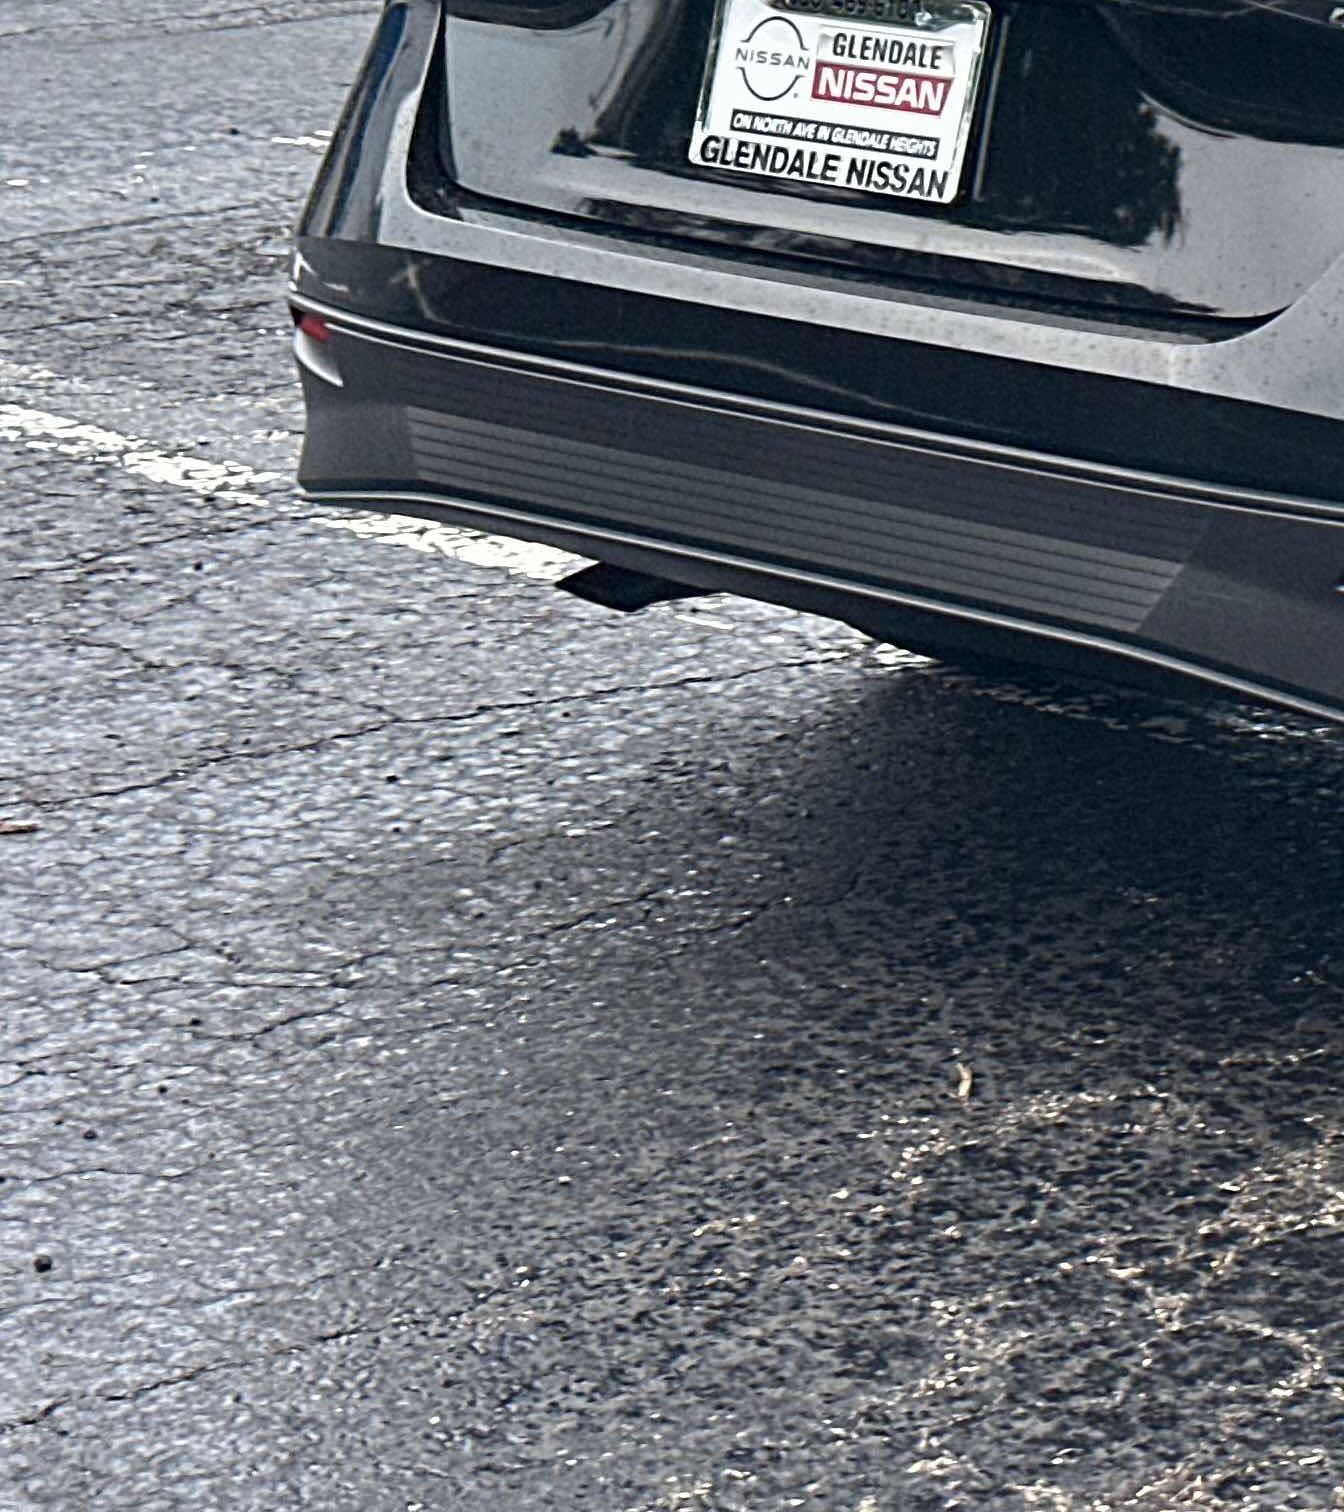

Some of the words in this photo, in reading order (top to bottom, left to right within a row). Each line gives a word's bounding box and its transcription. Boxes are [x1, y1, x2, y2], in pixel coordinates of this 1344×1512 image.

[735, 47, 811, 70] NISSAN
[832, 32, 943, 70] GLENDALE
[817, 65, 946, 112] NISSAN
[733, 112, 750, 129] ON
[752, 116, 793, 135] NORTH
[793, 122, 817, 139] AVE
[817, 126, 830, 140] IN
[831, 127, 889, 150] GLENDALE
[890, 136, 938, 157] HEIGHTS
[700, 135, 841, 182] GLENDALE
[845, 155, 950, 200] NISSAN
